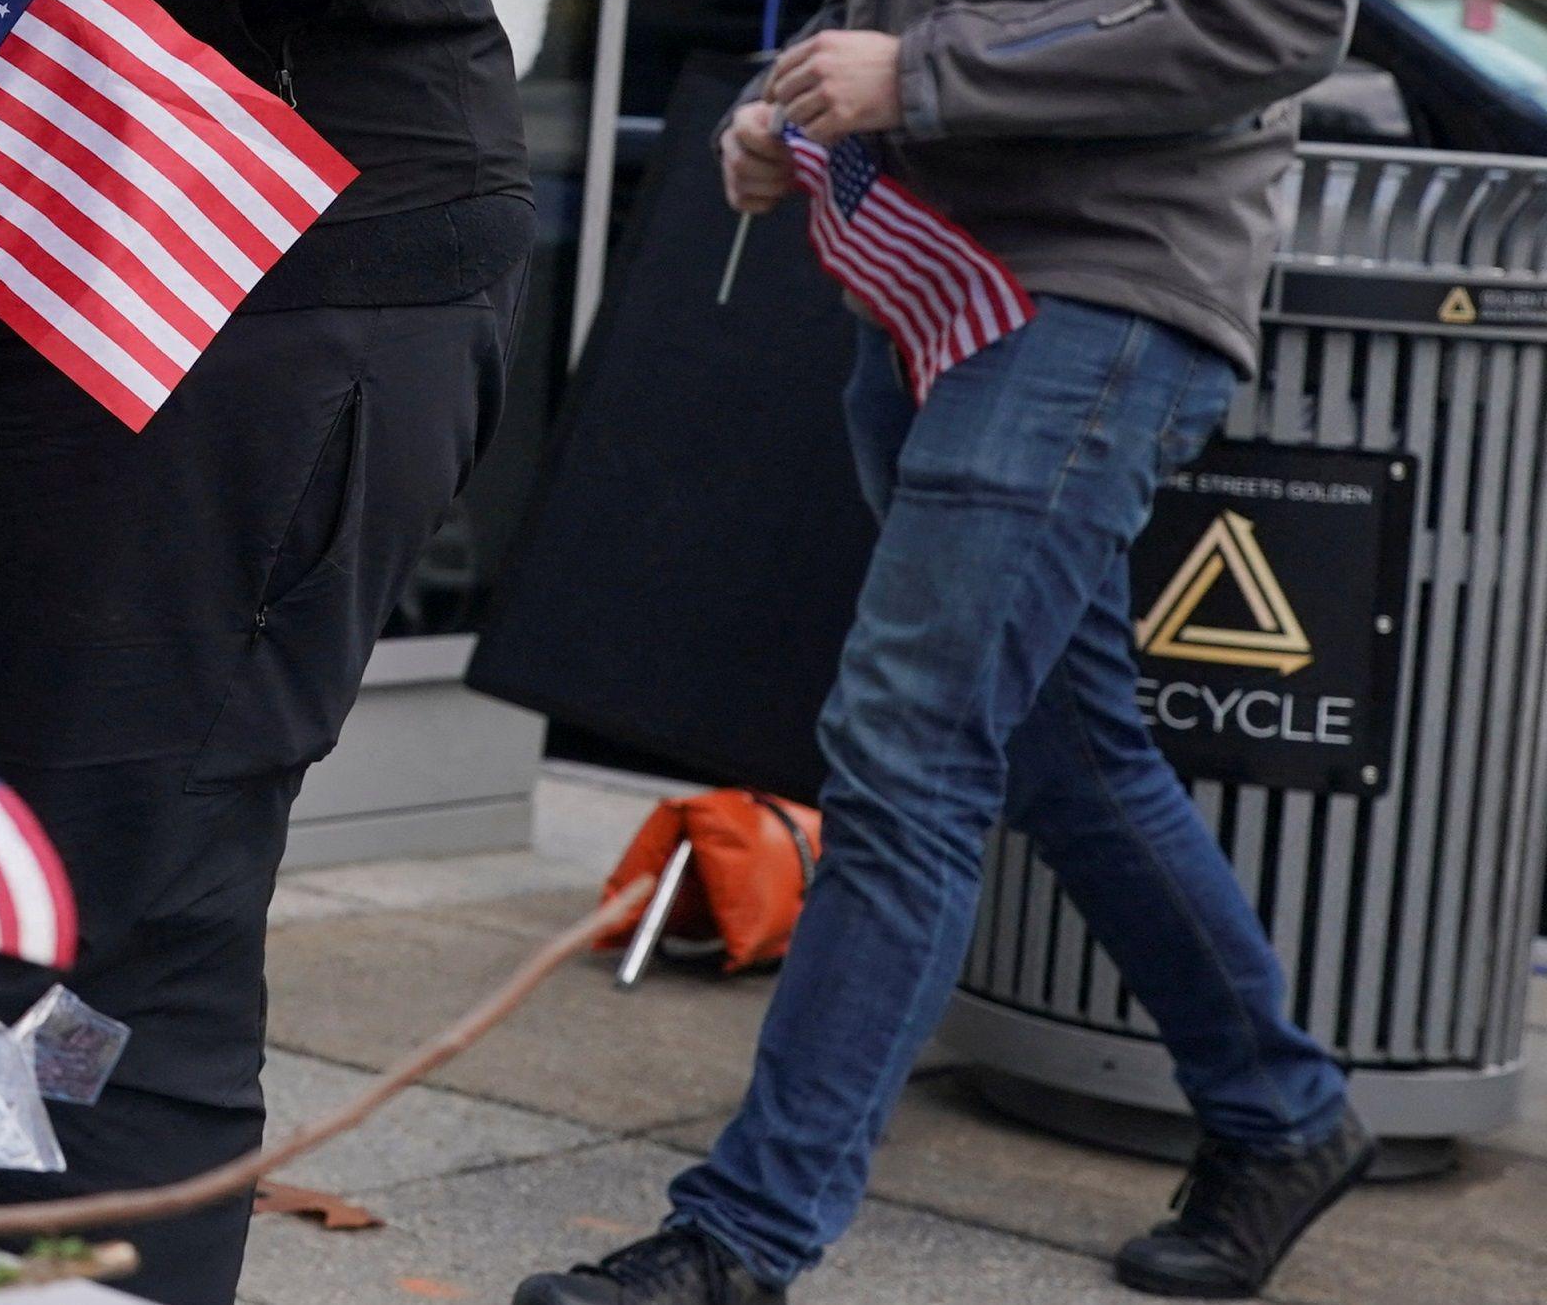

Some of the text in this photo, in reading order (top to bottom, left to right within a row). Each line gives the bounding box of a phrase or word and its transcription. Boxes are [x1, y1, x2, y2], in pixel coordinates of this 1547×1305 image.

[1196, 472, 1284, 500] STREETS
[1285, 480, 1374, 505] GOLDEN
[1135, 676, 1355, 745] ECYCLE
